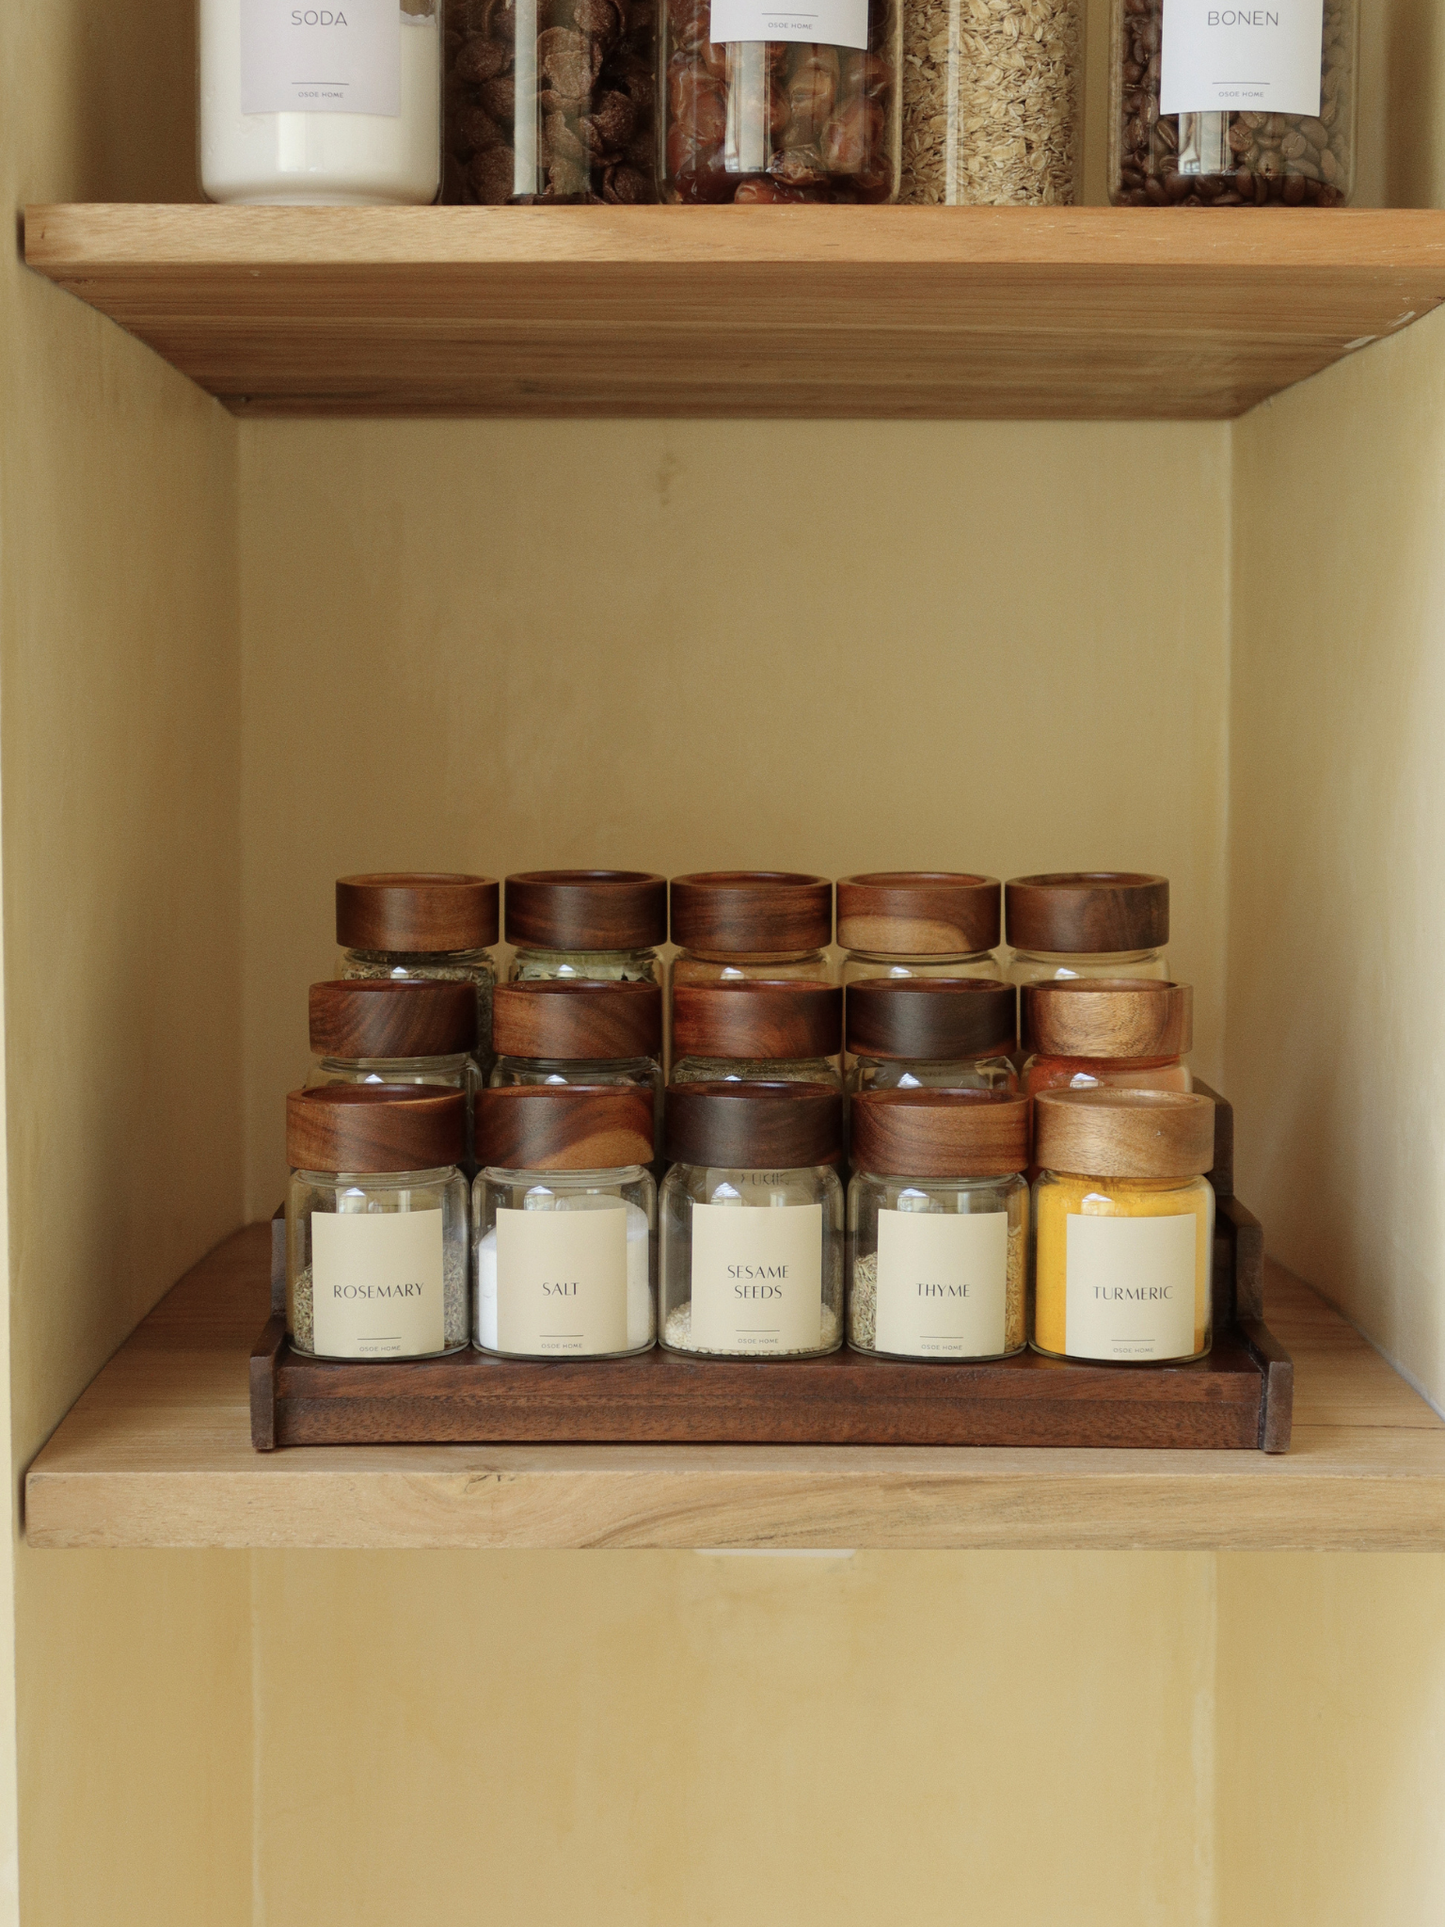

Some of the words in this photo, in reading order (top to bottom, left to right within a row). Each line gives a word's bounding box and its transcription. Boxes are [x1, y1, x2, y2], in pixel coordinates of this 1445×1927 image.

[291, 10, 348, 26] SODA
[1207, 10, 1279, 26] BONEN
[321, 91, 344, 99] HOME
[727, 1265, 790, 1279] SESAME
[333, 1282, 425, 1299] ROSEMARY
[542, 1282, 580, 1296] SALT
[734, 1285, 783, 1299] SEEDS
[915, 1283, 970, 1298] THYME
[1092, 1285, 1173, 1300] TURMERIC
